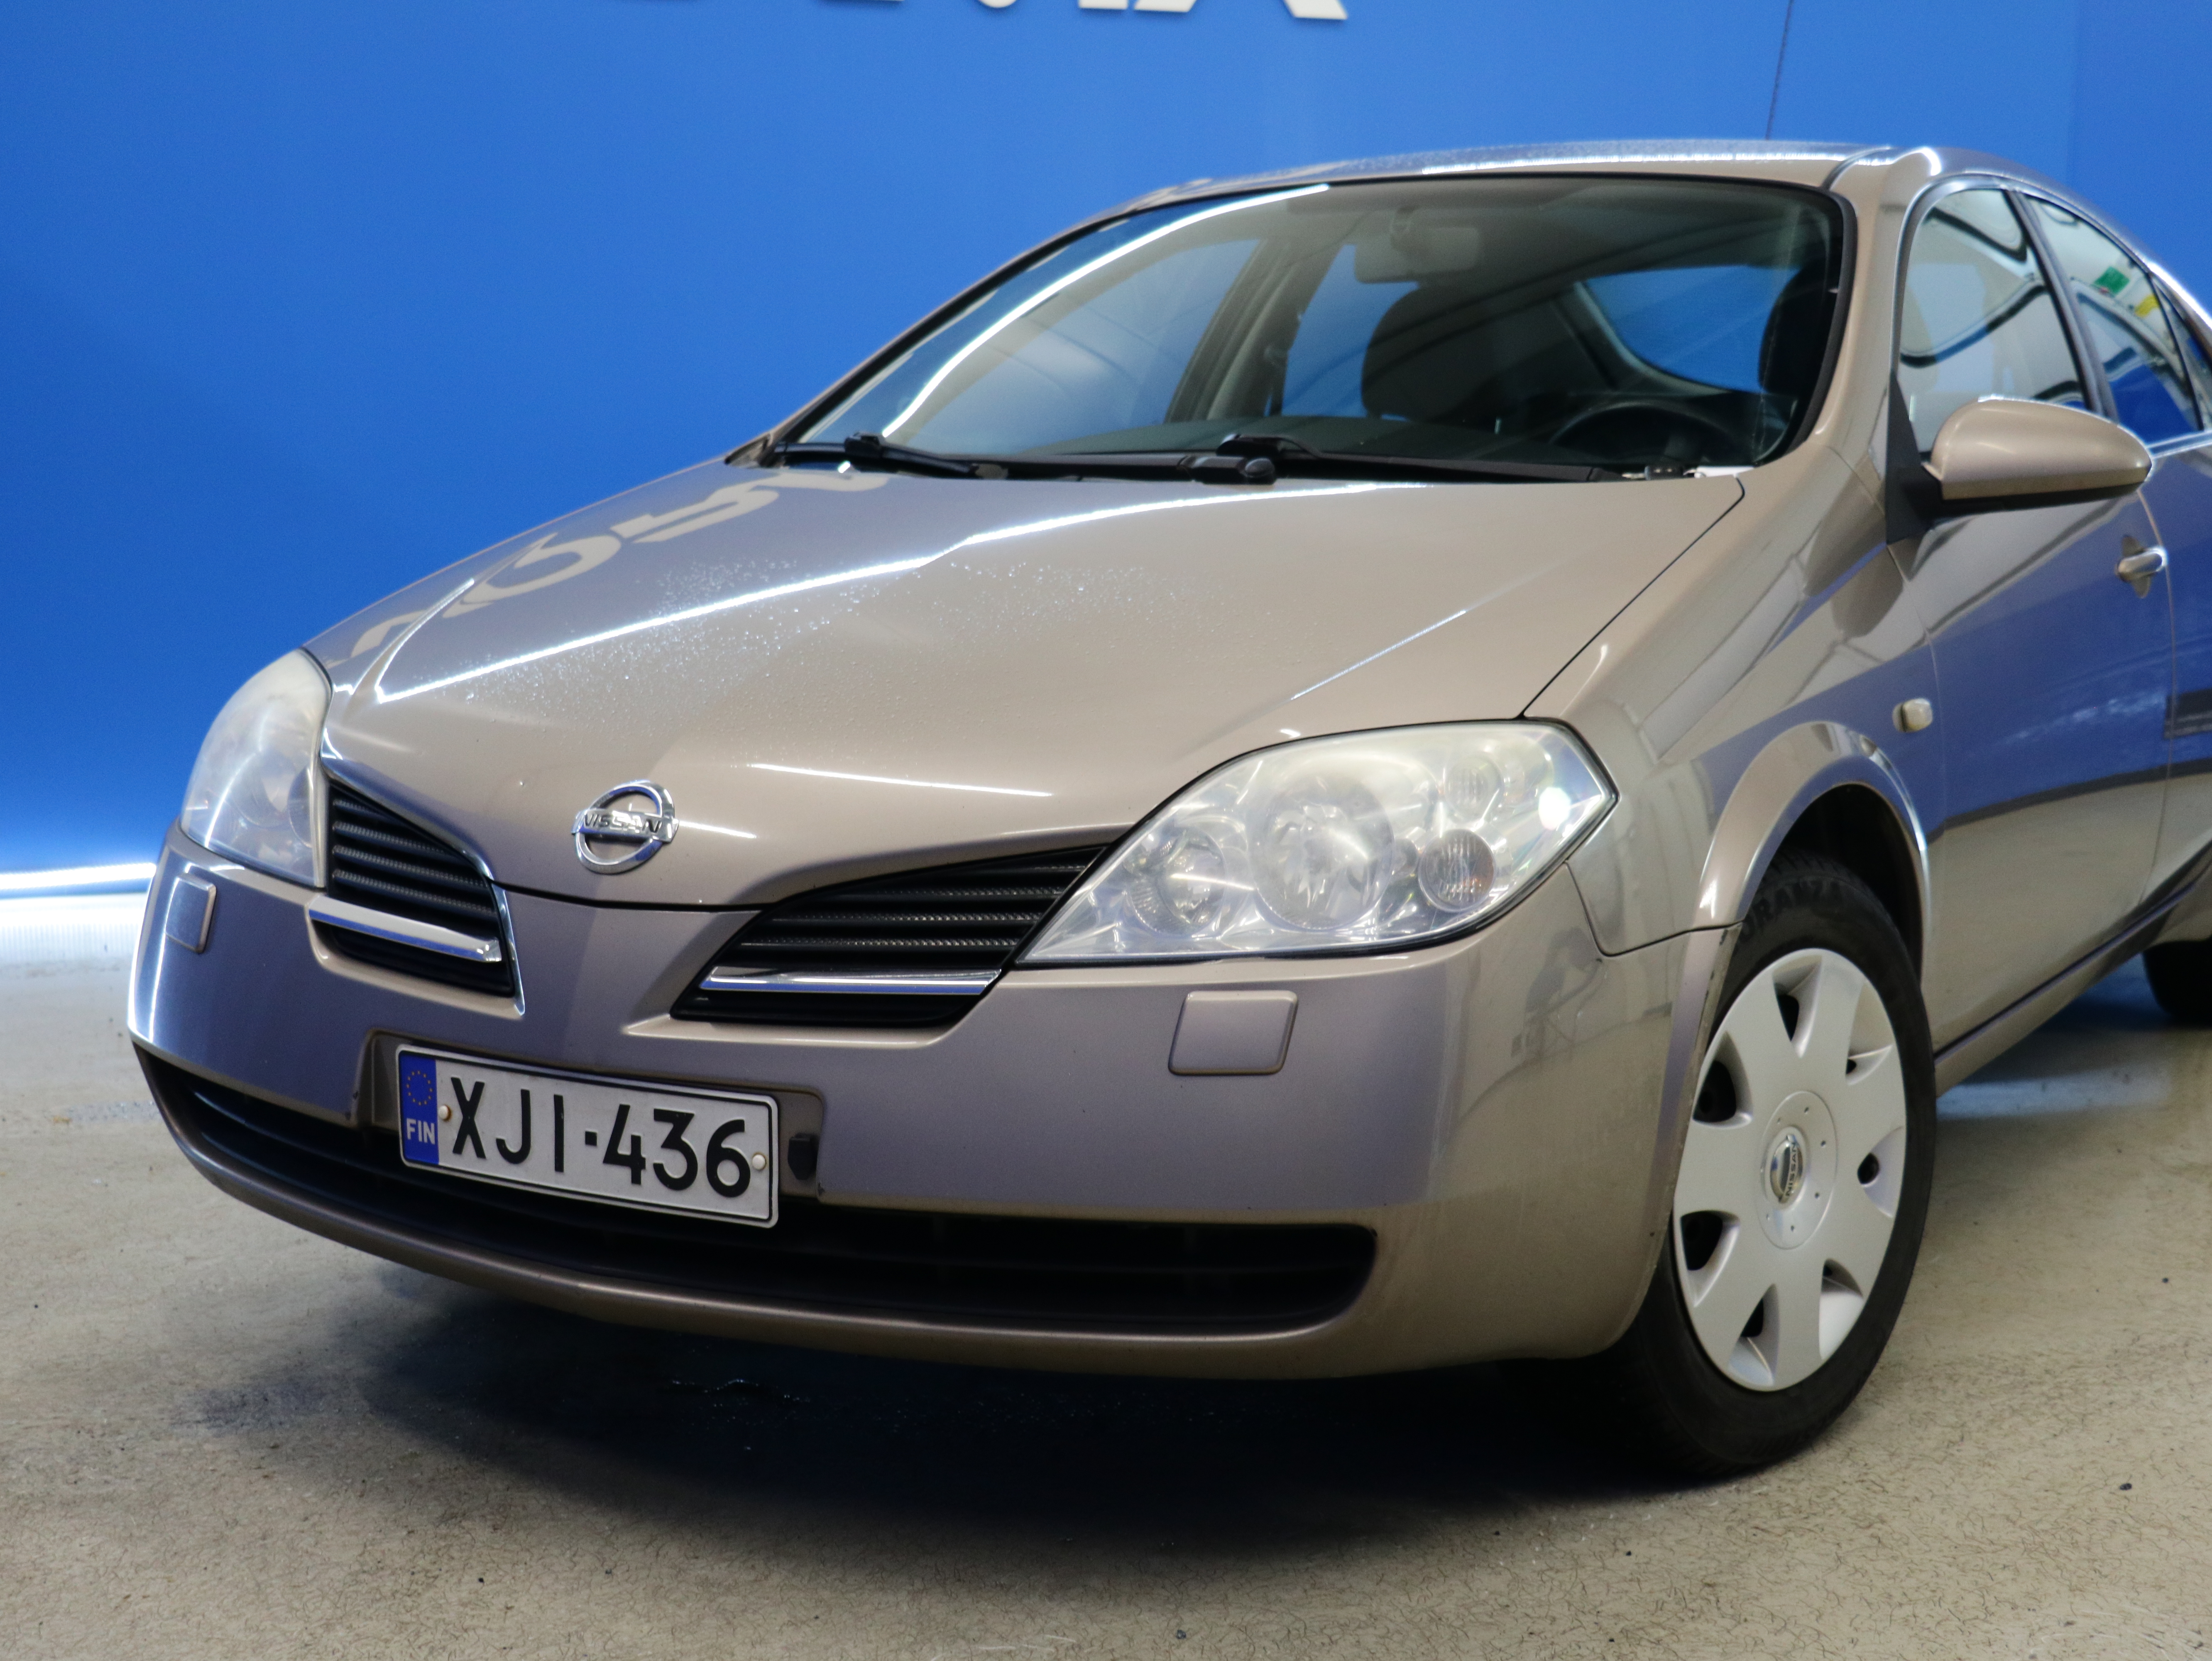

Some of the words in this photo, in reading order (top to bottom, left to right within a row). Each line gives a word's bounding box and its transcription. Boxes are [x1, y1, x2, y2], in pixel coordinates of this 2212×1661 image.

[1734, 879, 1842, 948] URANZA
[406, 1118, 436, 1144] FIN
[450, 1076, 751, 1199] XJI-436
[1785, 1141, 1797, 1196] NISSAN
